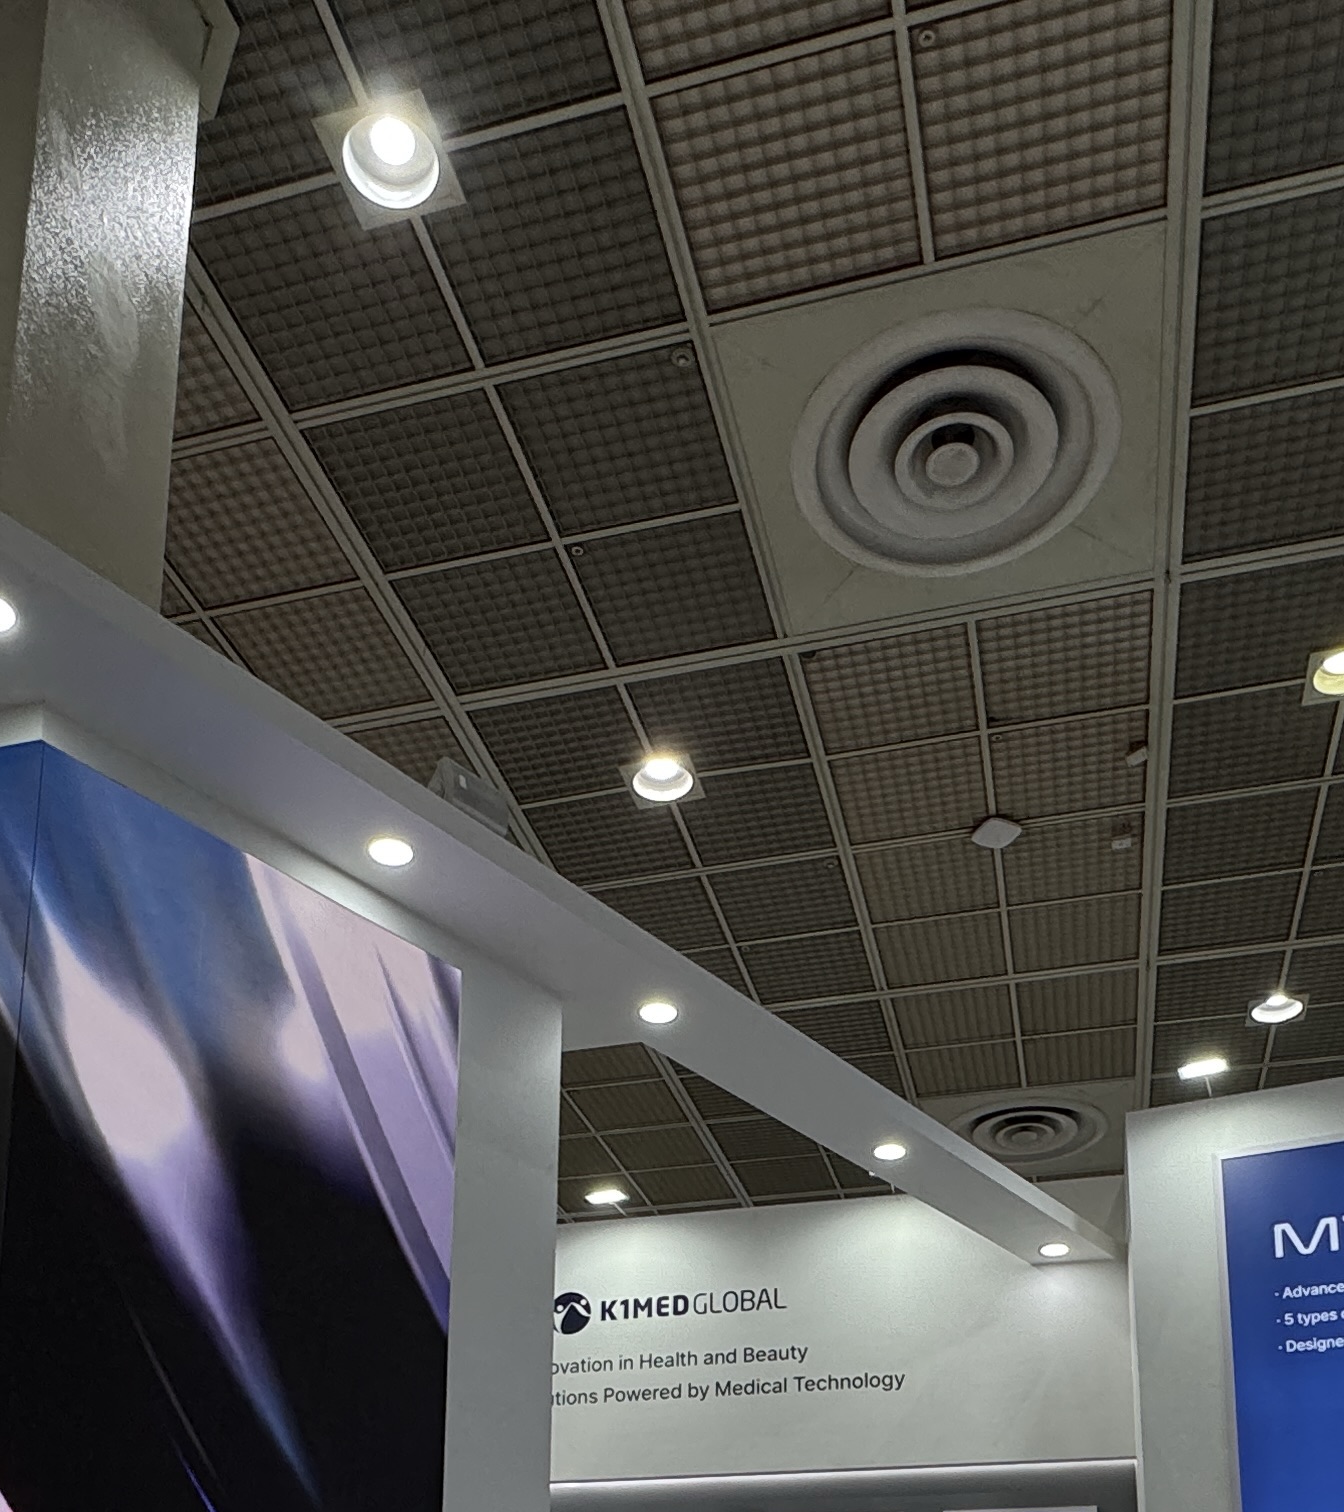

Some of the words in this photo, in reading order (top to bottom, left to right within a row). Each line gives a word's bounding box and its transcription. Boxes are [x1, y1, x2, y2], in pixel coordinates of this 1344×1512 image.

[1284, 1312, 1295, 1326] 5
[1297, 1310, 1338, 1327] types
[618, 1354, 634, 1371] in
[639, 1351, 698, 1370] Health
[703, 1348, 737, 1366] and
[743, 1345, 809, 1364] Beauty
[604, 1382, 682, 1404] Powered
[687, 1382, 710, 1402] by
[715, 1377, 787, 1398] Medical
[793, 1372, 906, 1393] Technology
